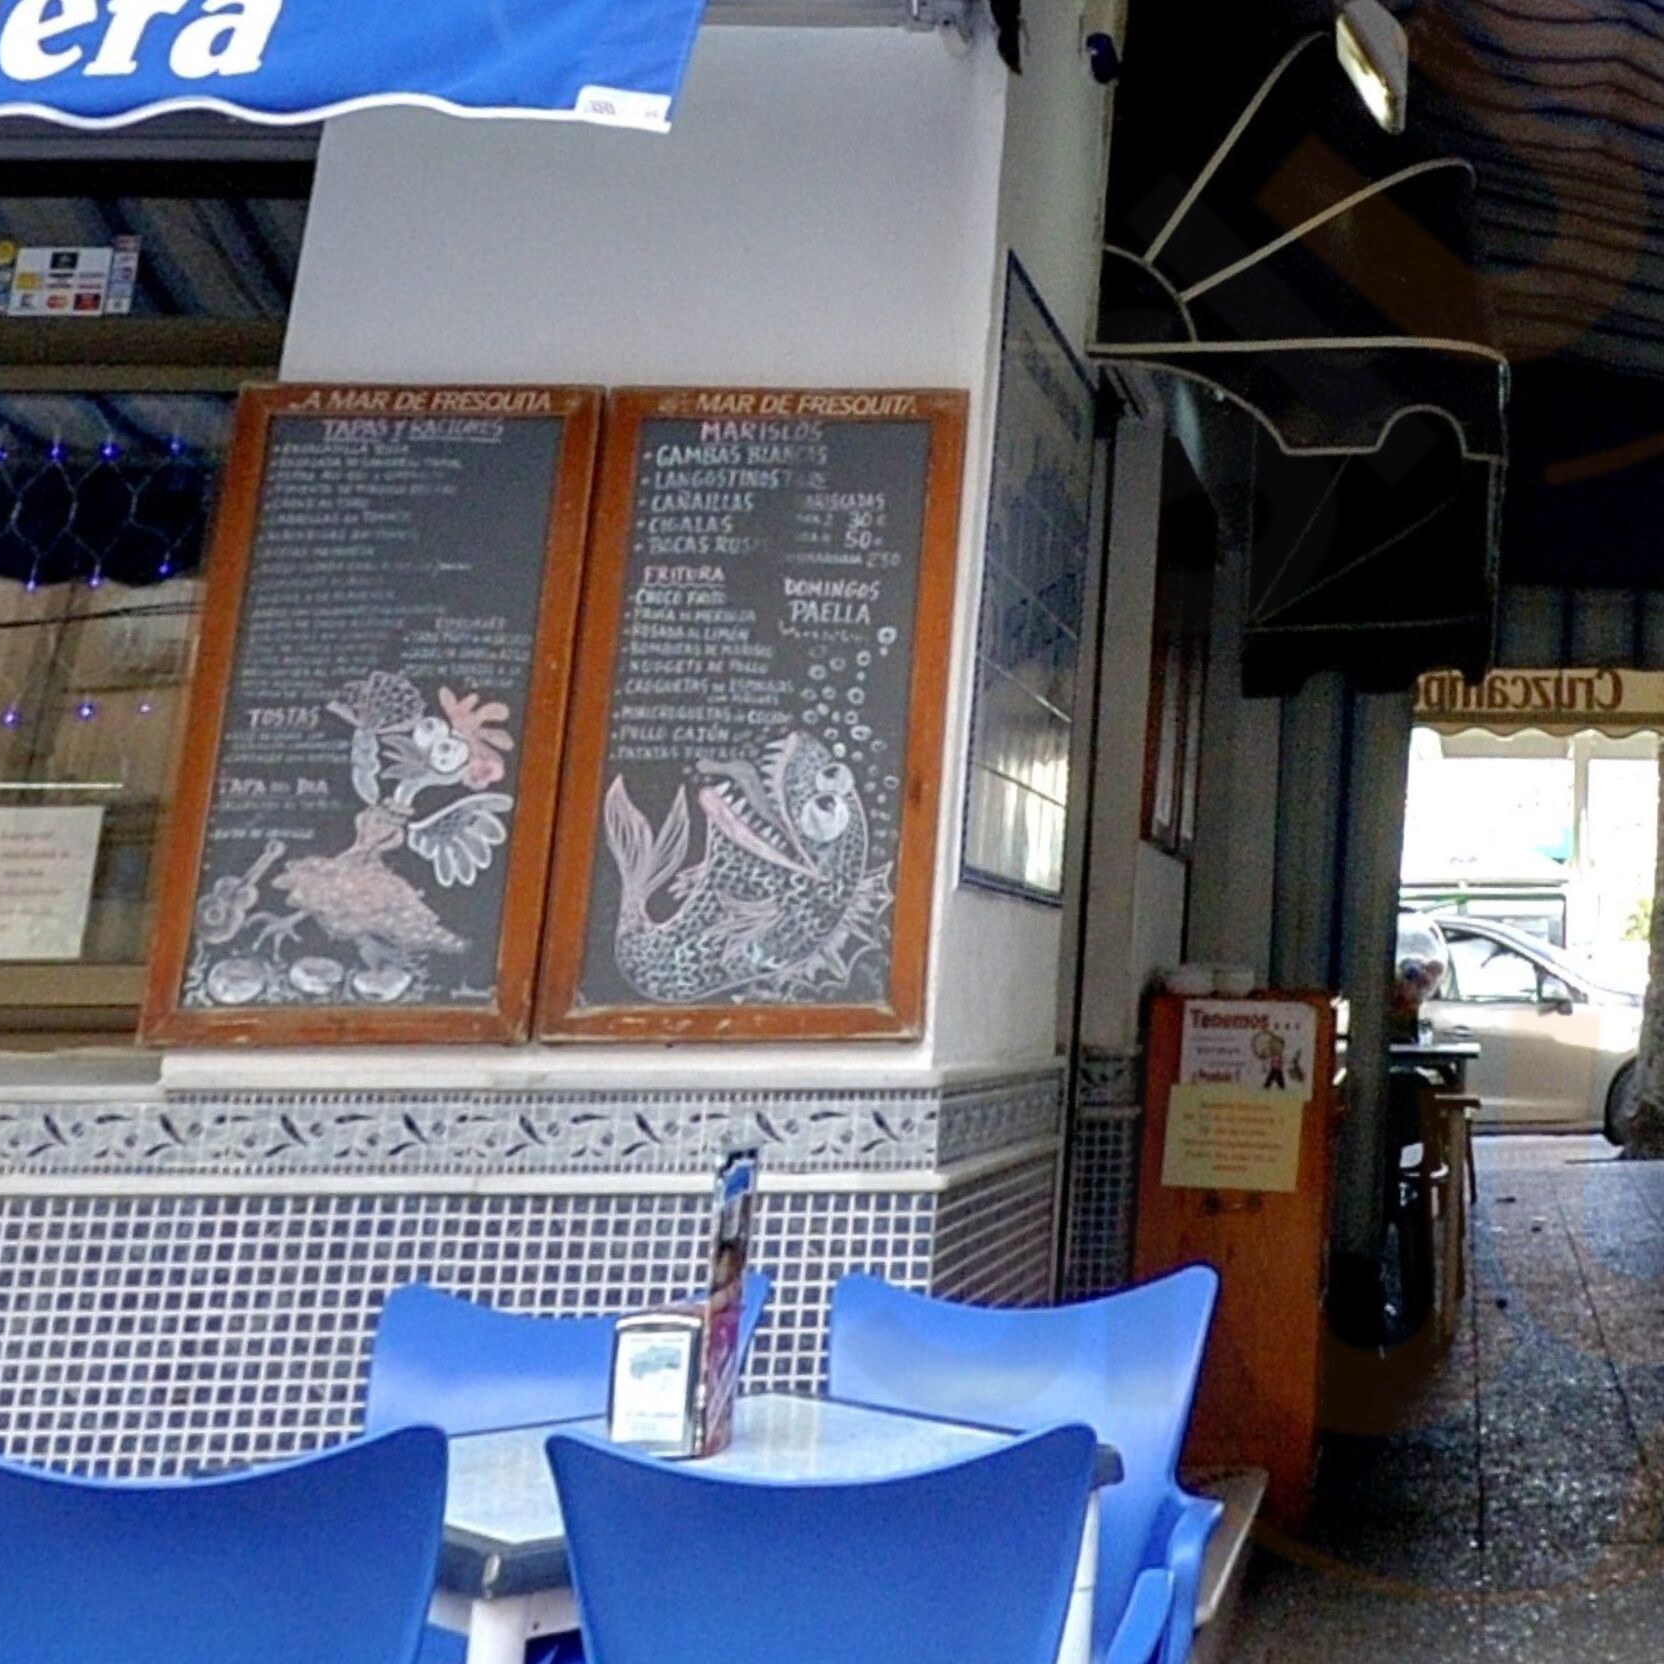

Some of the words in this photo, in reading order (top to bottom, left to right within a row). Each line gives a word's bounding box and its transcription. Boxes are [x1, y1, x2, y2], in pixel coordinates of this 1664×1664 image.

[327, 390, 389, 411] MAR
[393, 391, 428, 412] DE
[696, 393, 755, 414] MAR
[759, 394, 793, 414] DE
[700, 419, 823, 442] MARISCOS
[656, 444, 741, 467] GAMBAS
[844, 530, 872, 550] 50
[644, 565, 725, 582] FRITURA
[783, 576, 882, 601] DOMINGOS
[788, 598, 872, 625] PAELLA
[247, 706, 321, 729] TOSTAS
